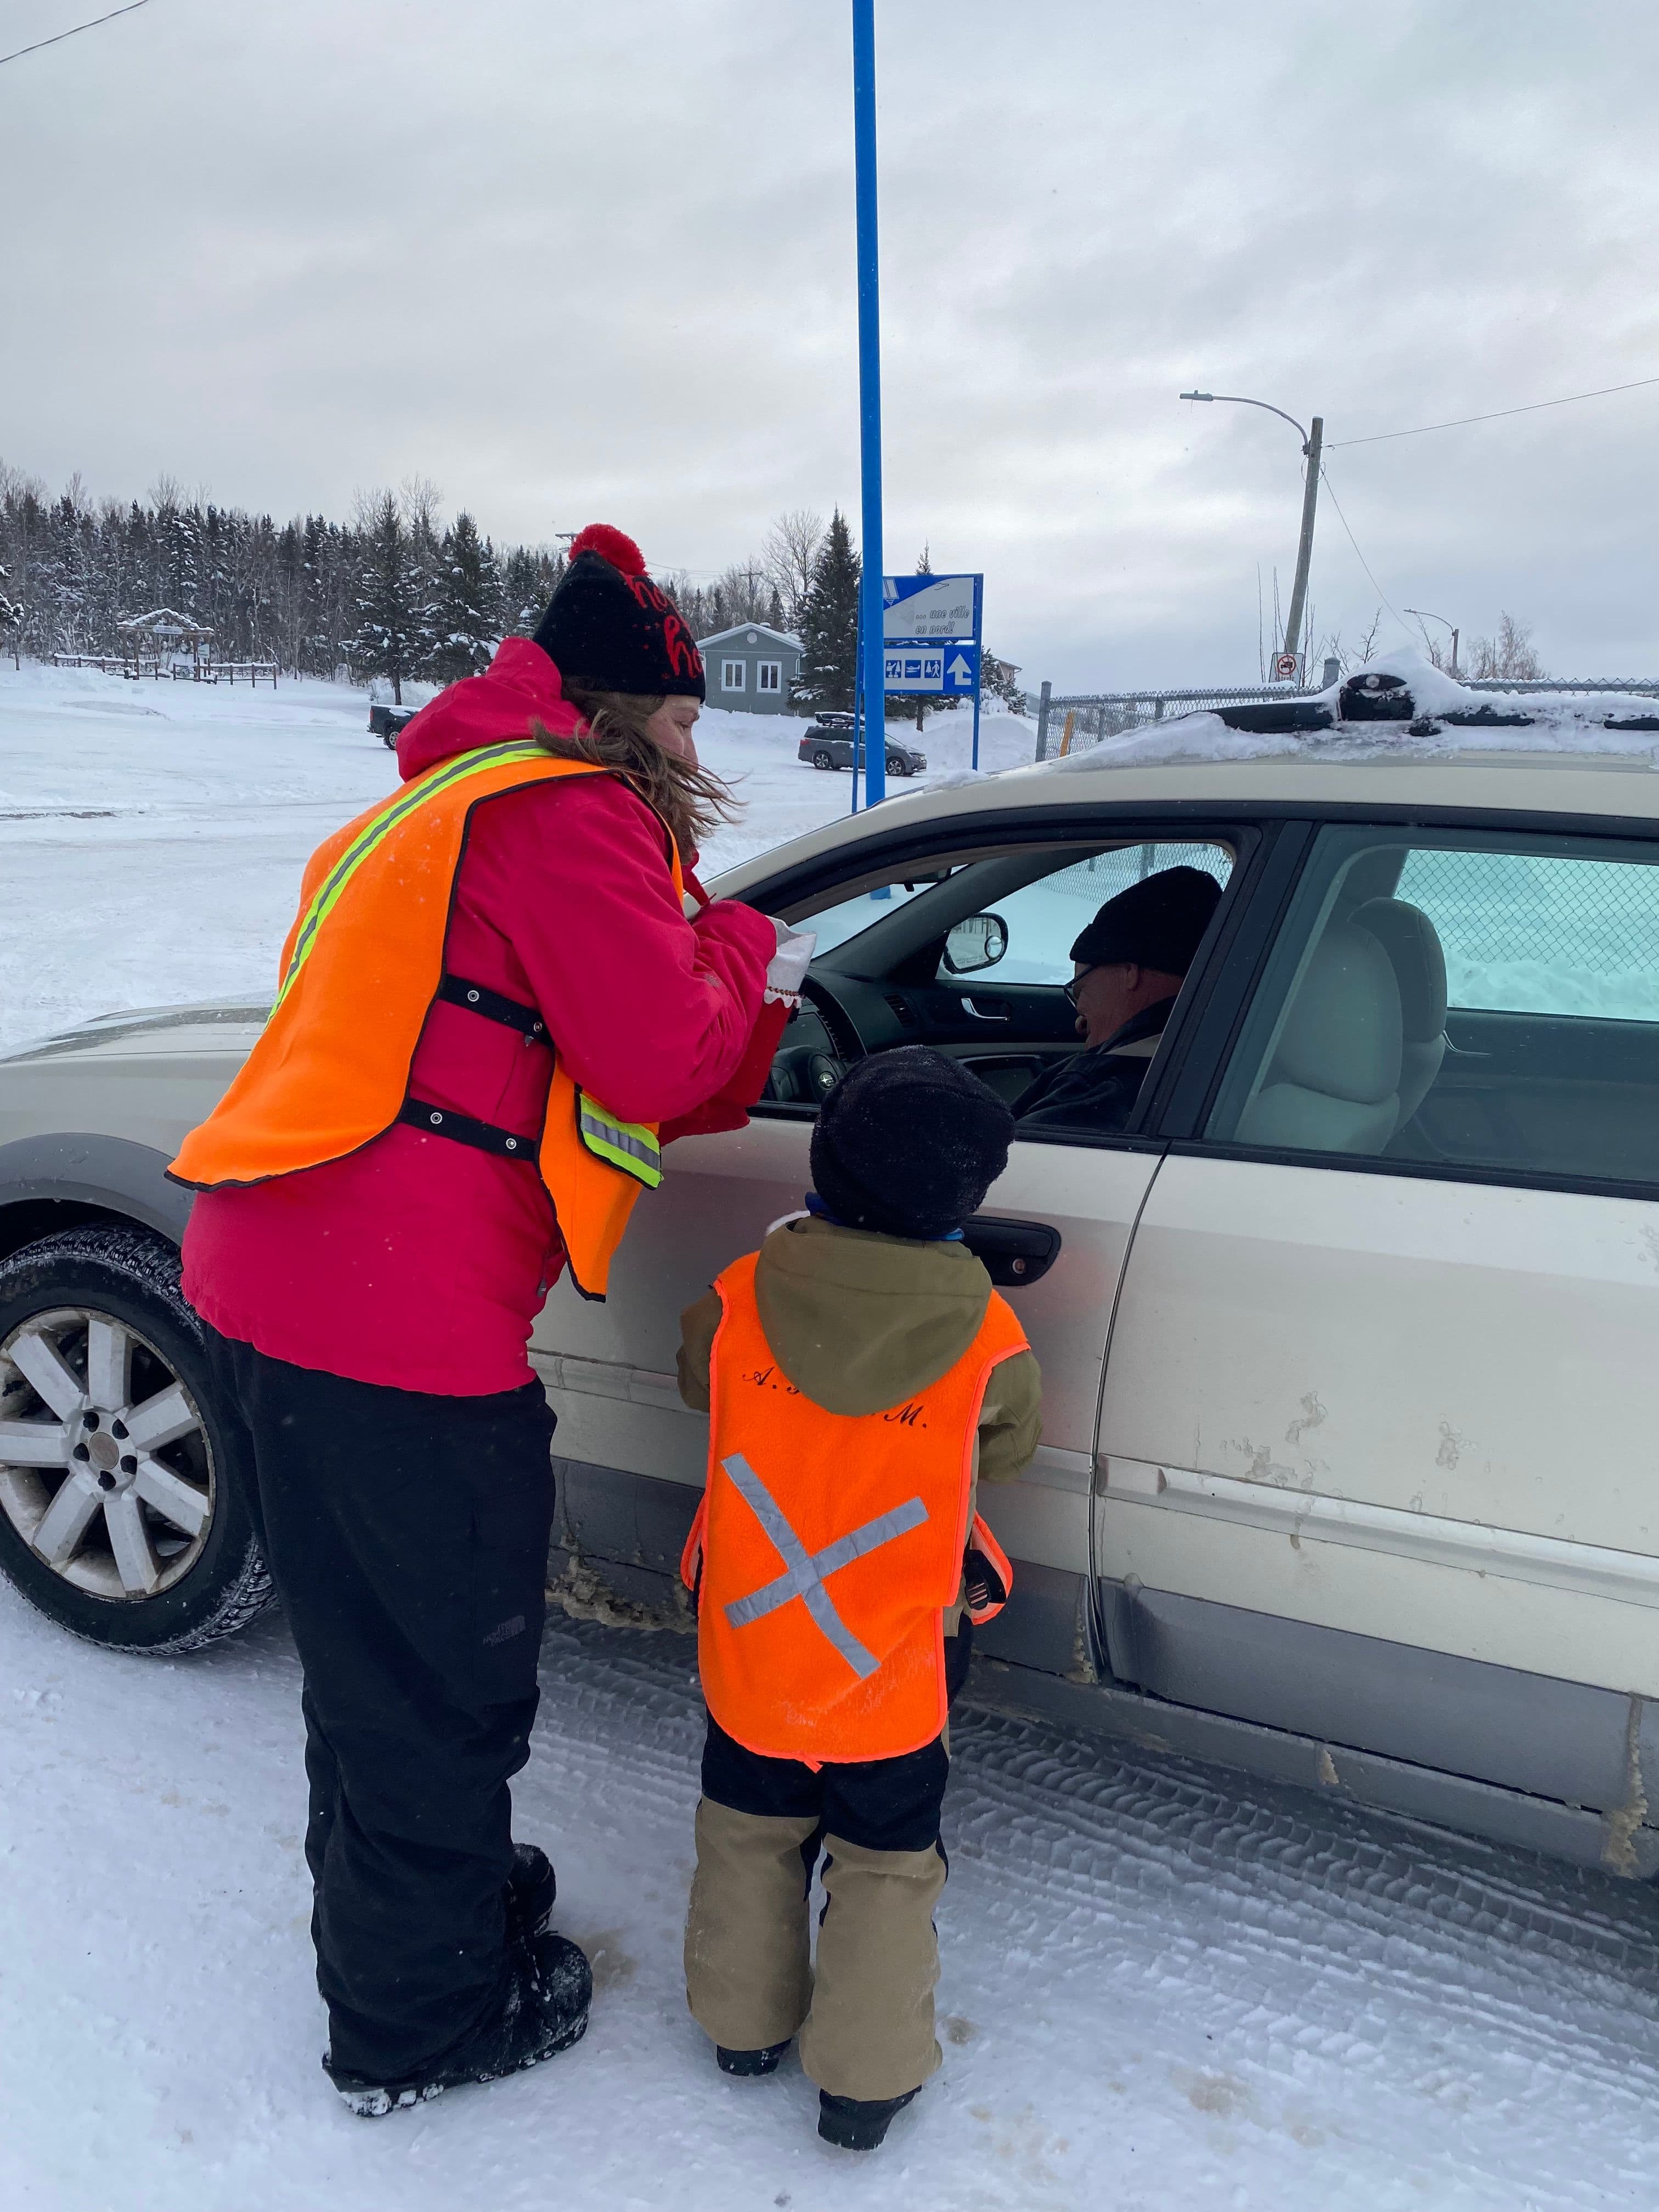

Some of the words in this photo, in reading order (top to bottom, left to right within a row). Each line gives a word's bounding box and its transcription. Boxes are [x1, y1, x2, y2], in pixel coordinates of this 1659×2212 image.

[929, 610, 947, 619] une
[949, 606, 970, 618] ville
[915, 625, 927, 634] en
[929, 621, 955, 634] nord!
[883, 1402, 927, 1429] M.
